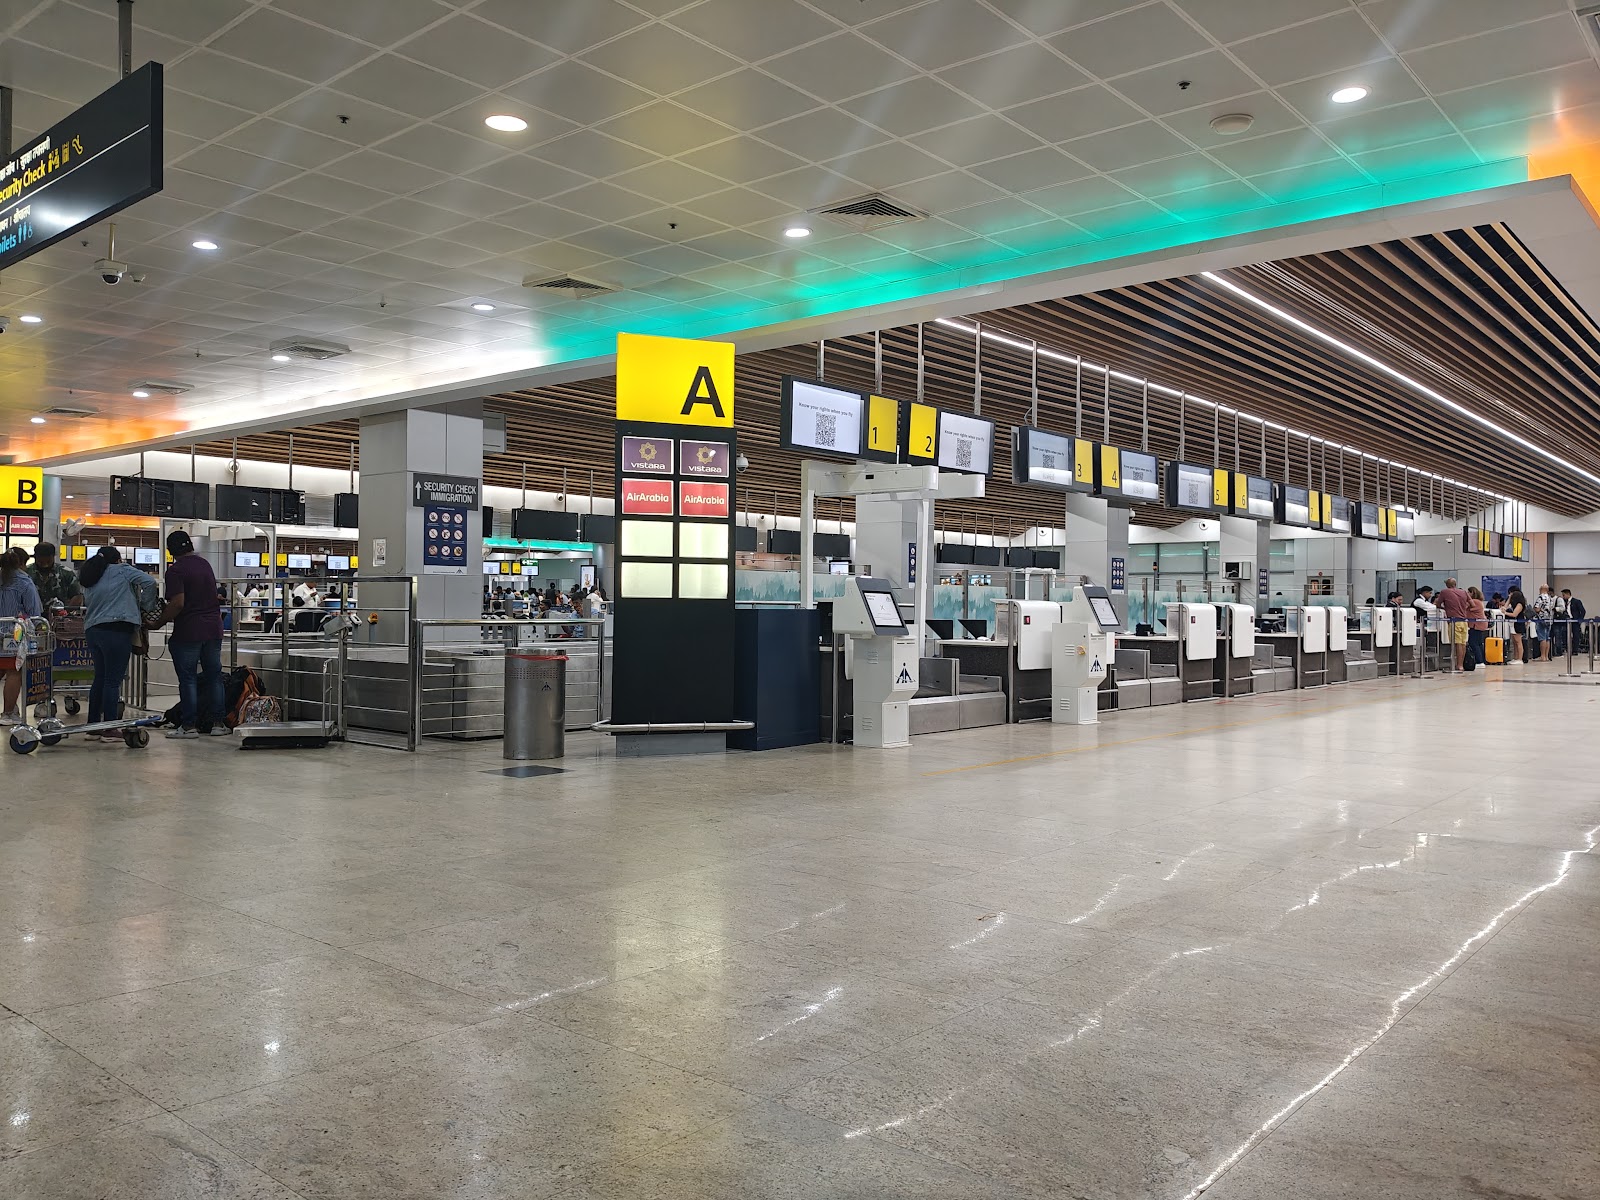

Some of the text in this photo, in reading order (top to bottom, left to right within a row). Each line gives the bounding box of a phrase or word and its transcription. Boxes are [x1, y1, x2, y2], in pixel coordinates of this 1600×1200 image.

[0, 160, 46, 203] ecurity Check
[680, 365, 725, 418] A
[872, 426, 878, 444] 1
[925, 435, 932, 453] 2
[1077, 464, 1082, 477] 3
[1111, 470, 1117, 483] 4
[18, 479, 37, 504] B
[423, 482, 476, 495] SECURITY CHECK
[1216, 489, 1220, 501] 5
[431, 492, 472, 503] IMMIGRATION
[626, 492, 669, 502] AirArabia
[684, 494, 725, 505] AirArabia
[1241, 495, 1246, 506] 6
[60, 640, 88, 649] MAJE
